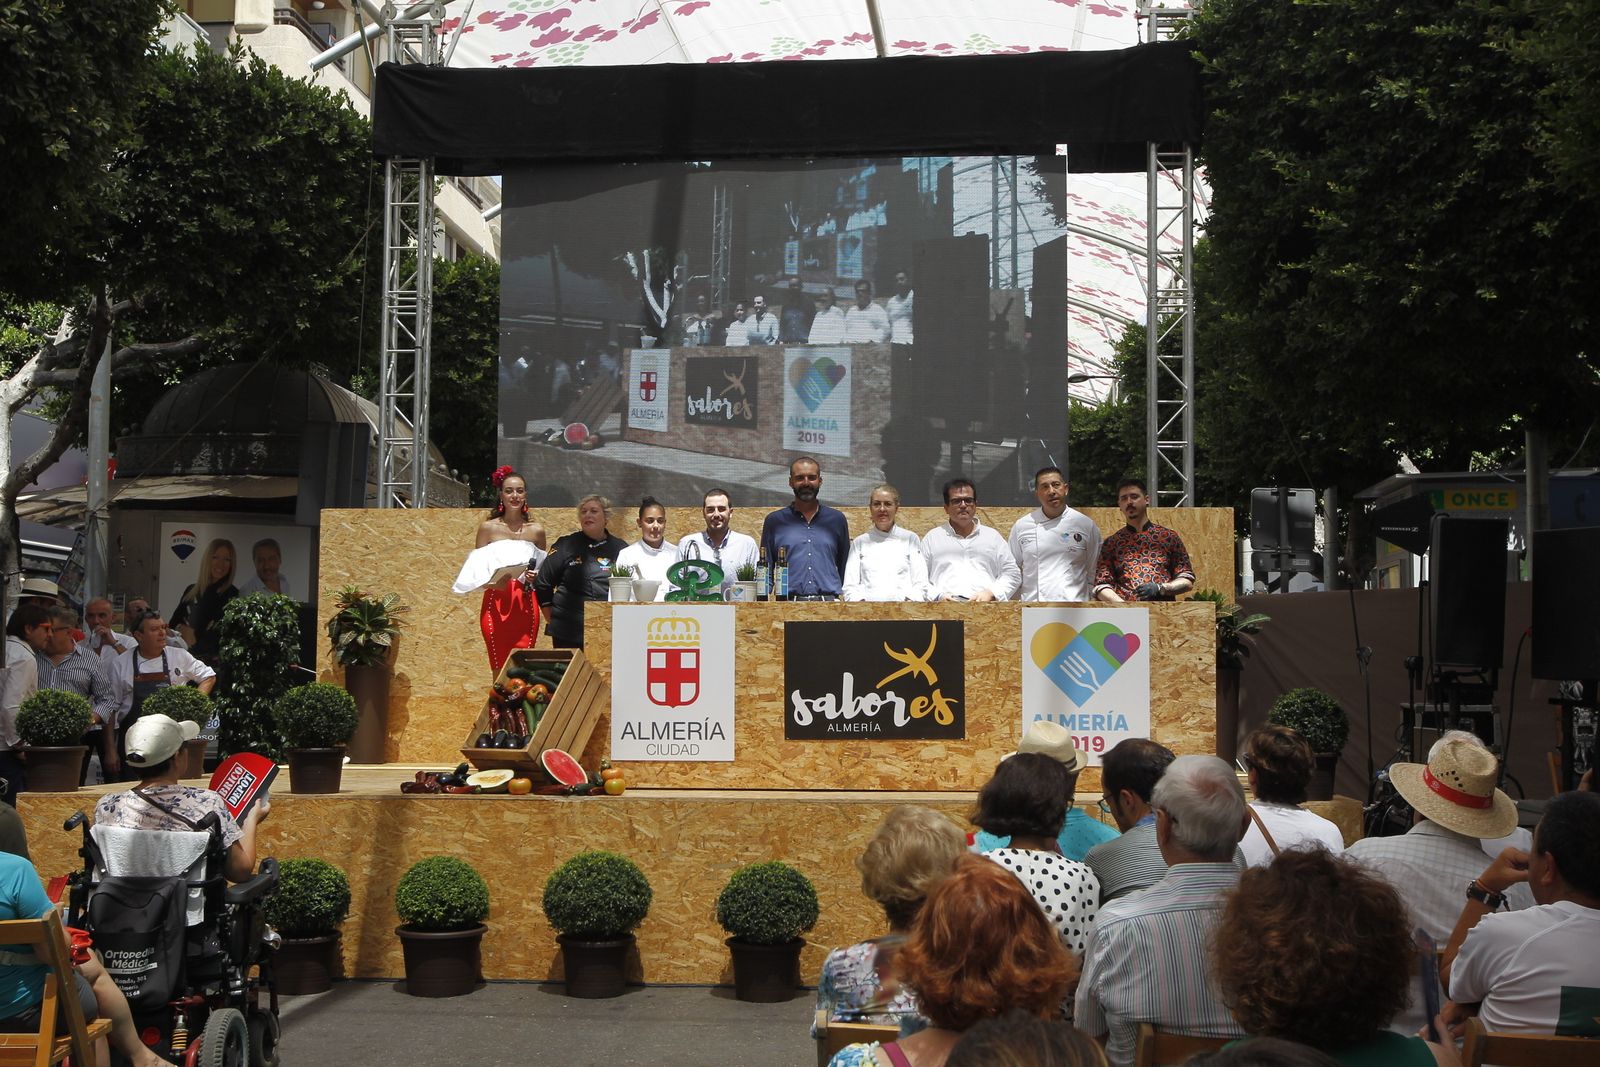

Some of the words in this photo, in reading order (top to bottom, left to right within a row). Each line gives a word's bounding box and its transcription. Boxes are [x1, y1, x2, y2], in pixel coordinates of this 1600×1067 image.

[687, 386, 753, 420] sabores
[787, 416, 839, 432] ALMERÍA
[797, 431, 826, 444] 2019
[1452, 492, 1509, 506] ONCE
[791, 672, 959, 728] sabores
[621, 717, 726, 741] ALMERÍA
[827, 721, 881, 732] ALMERÍA
[646, 743, 700, 756] CIUDAD
[1070, 735, 1105, 752] 019
[218, 766, 243, 798] BRICO
[104, 947, 155, 959] Ortopedia
[111, 958, 149, 969] Médica
